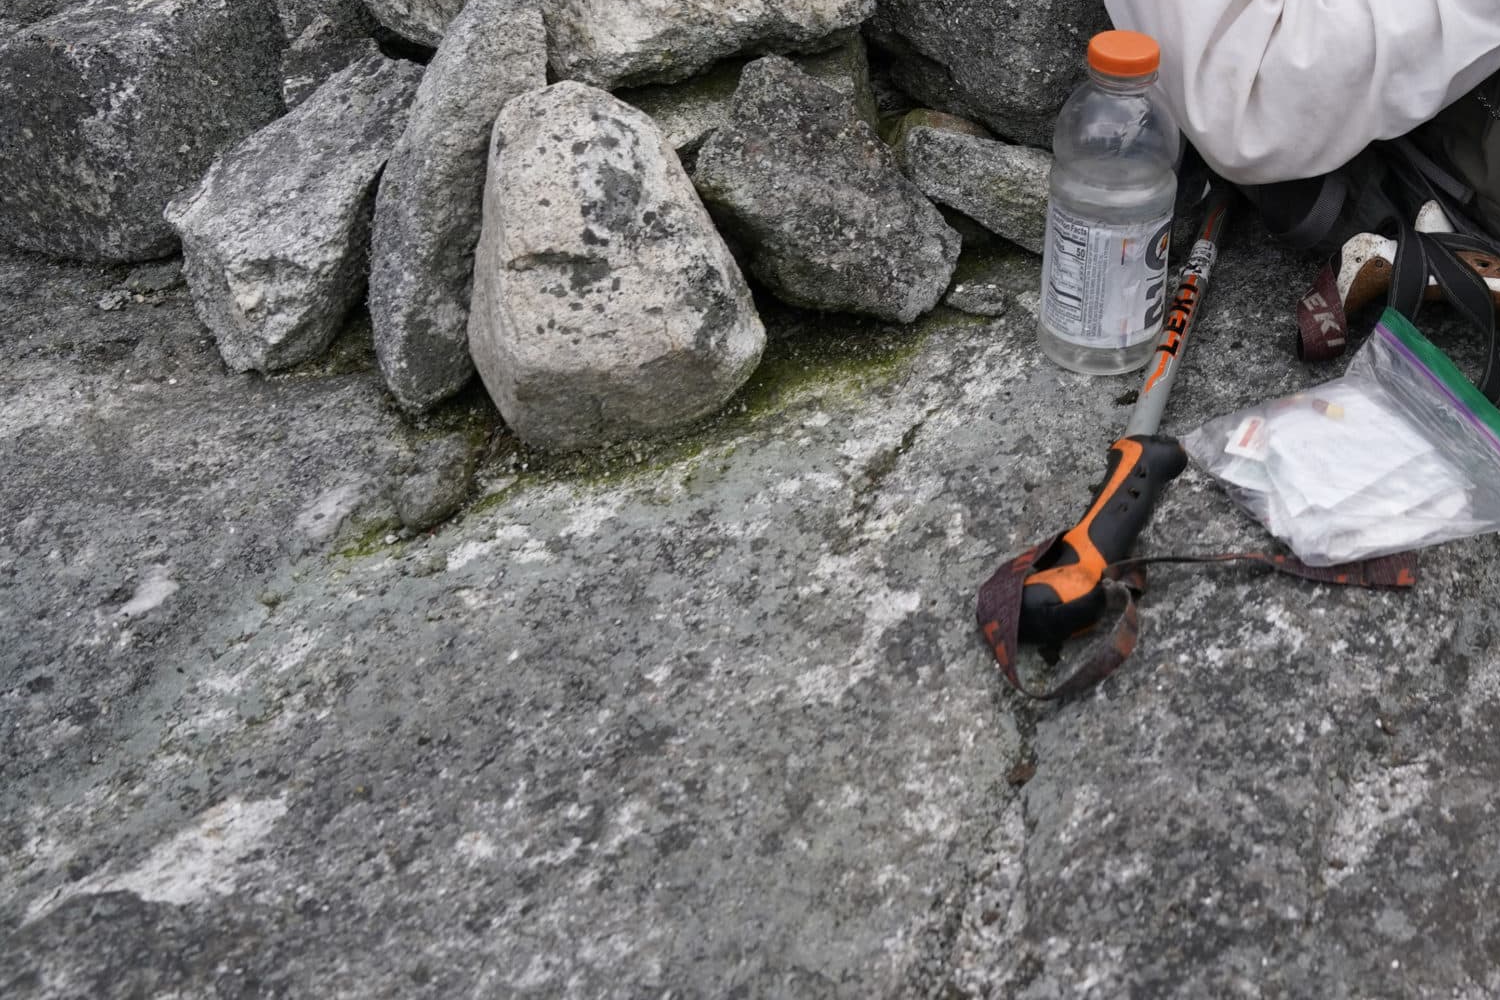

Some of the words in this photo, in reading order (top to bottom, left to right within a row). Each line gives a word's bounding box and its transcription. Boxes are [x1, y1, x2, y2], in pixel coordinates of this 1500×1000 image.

[1076, 248, 1085, 258] 50
[1155, 282, 1199, 358] LEKI
[1302, 289, 1345, 347] EKI
